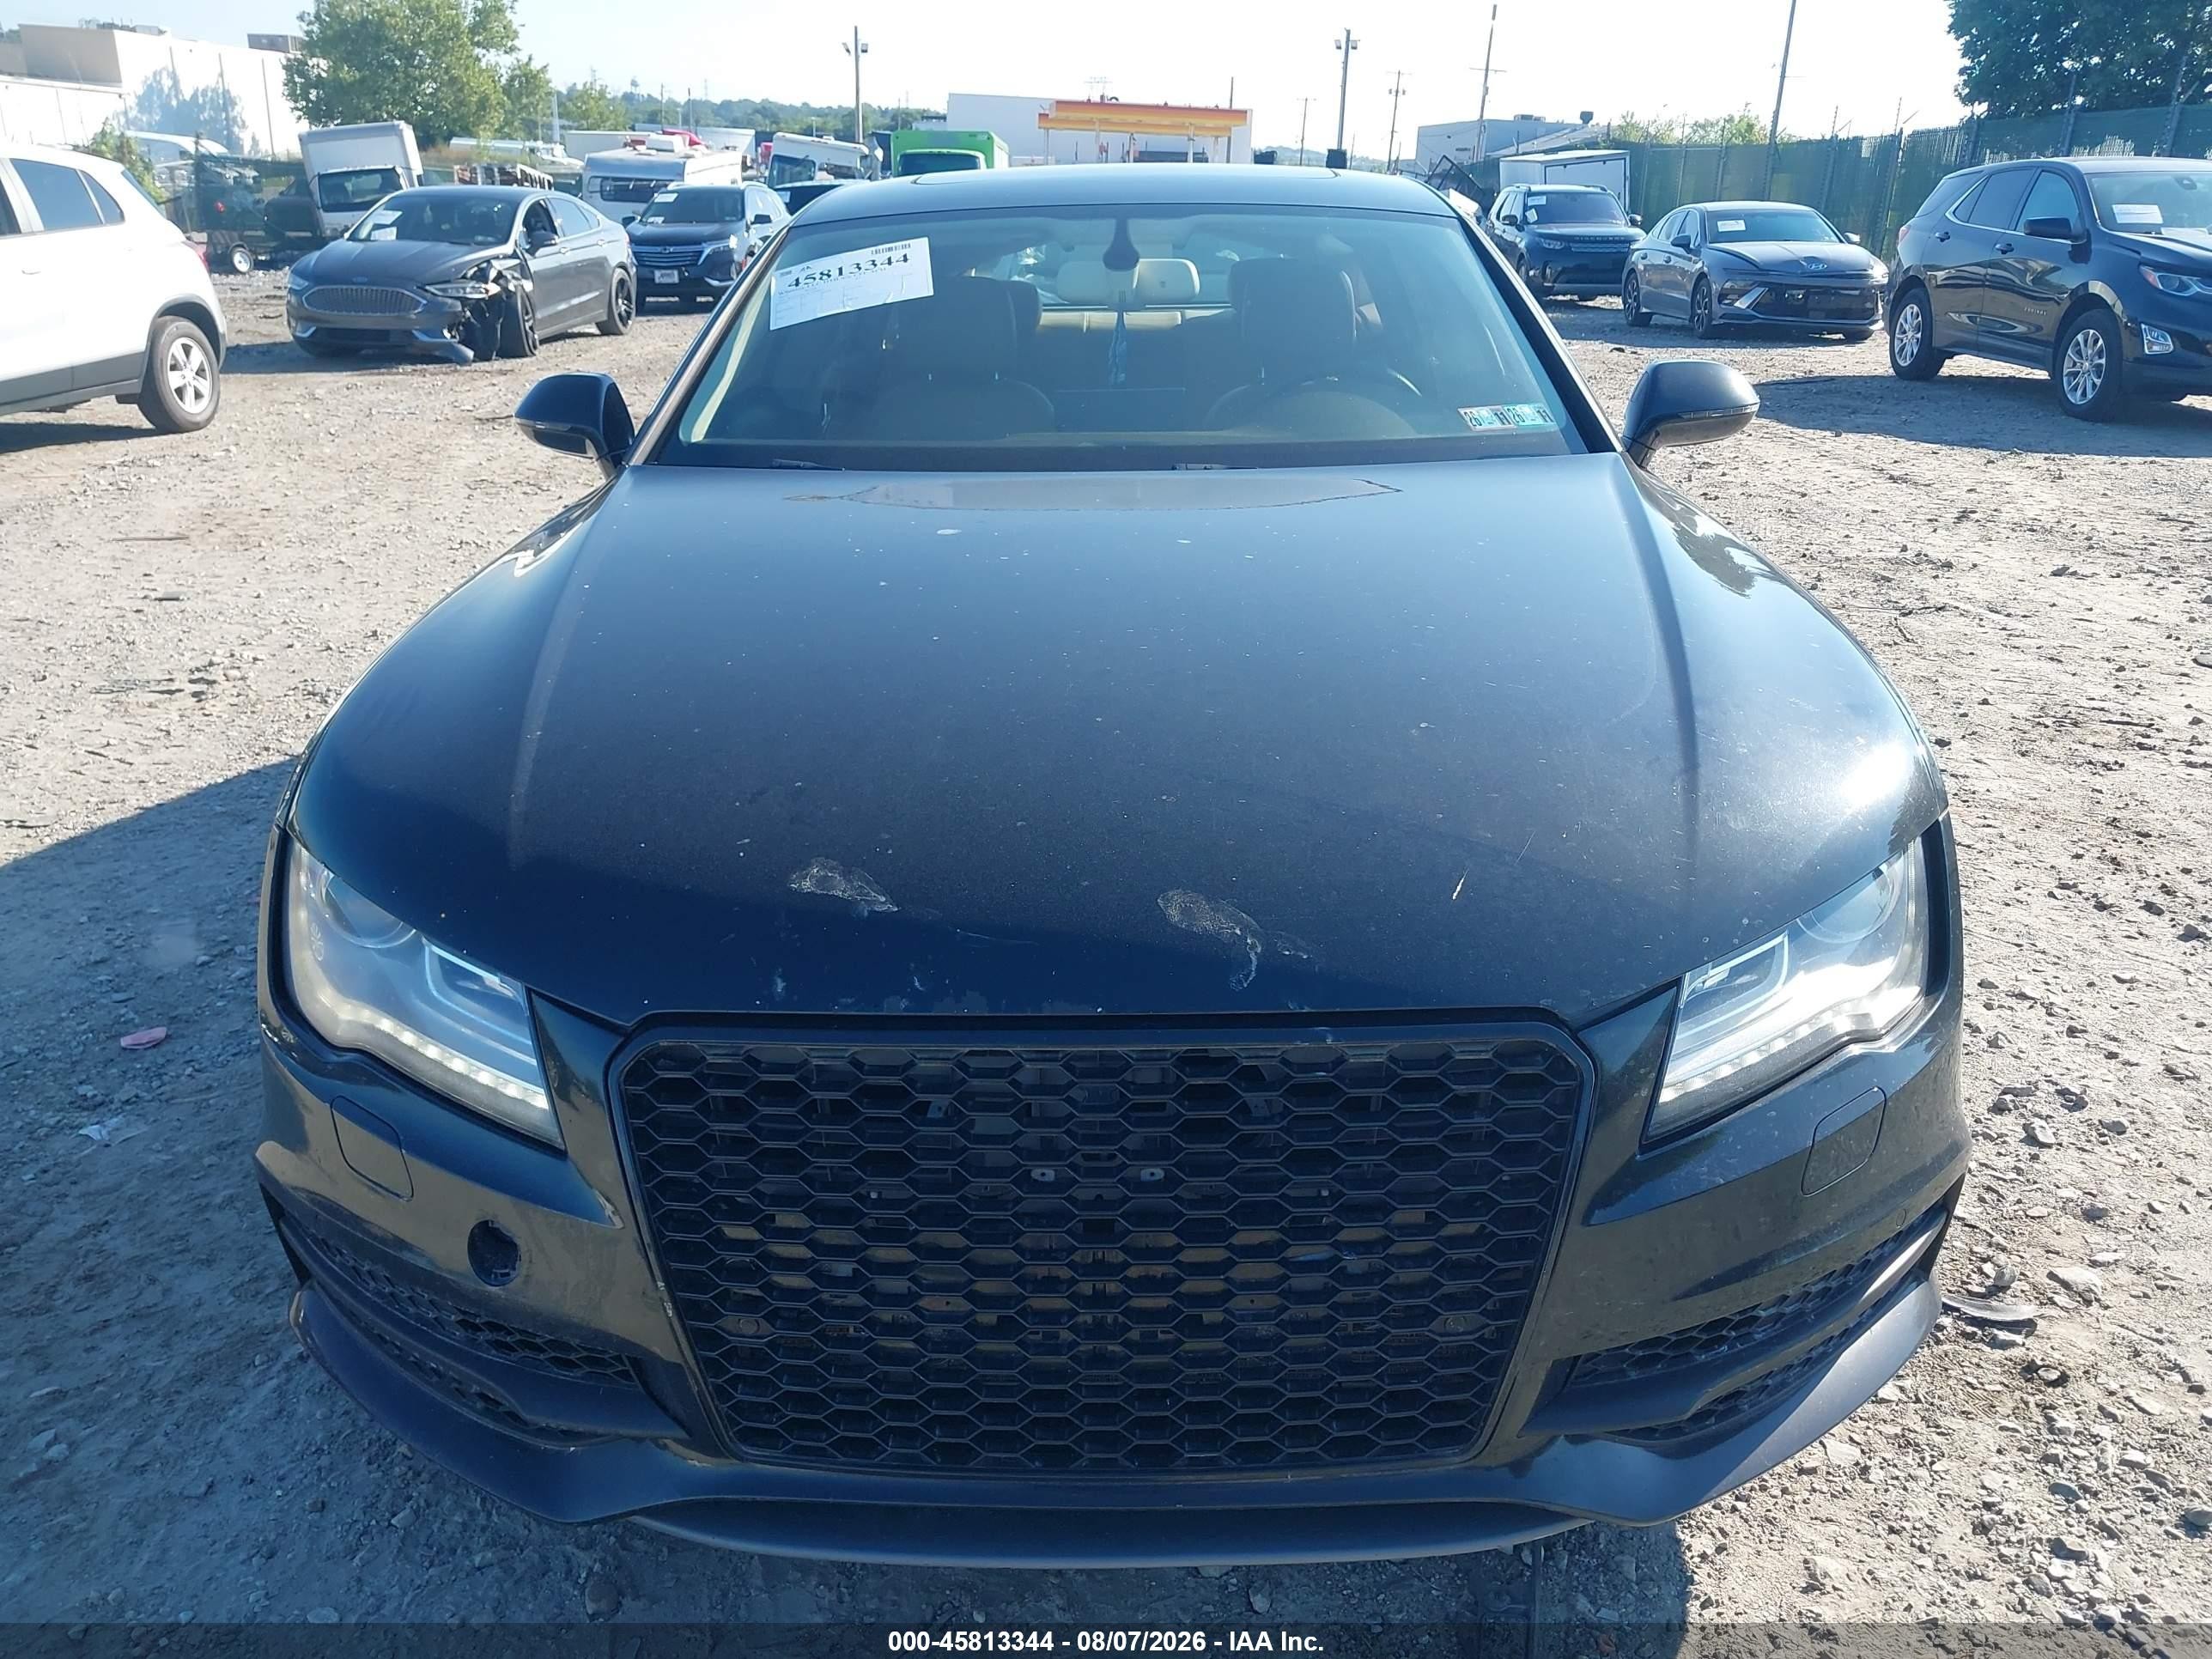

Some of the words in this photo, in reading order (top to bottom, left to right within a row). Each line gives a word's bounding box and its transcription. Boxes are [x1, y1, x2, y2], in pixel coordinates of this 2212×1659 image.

[787, 252, 911, 288] 45813344
[1463, 411, 1483, 427] 26
[1494, 412, 1512, 426] 11
[1506, 407, 1526, 423] 26
[1536, 409, 1555, 423] 11
